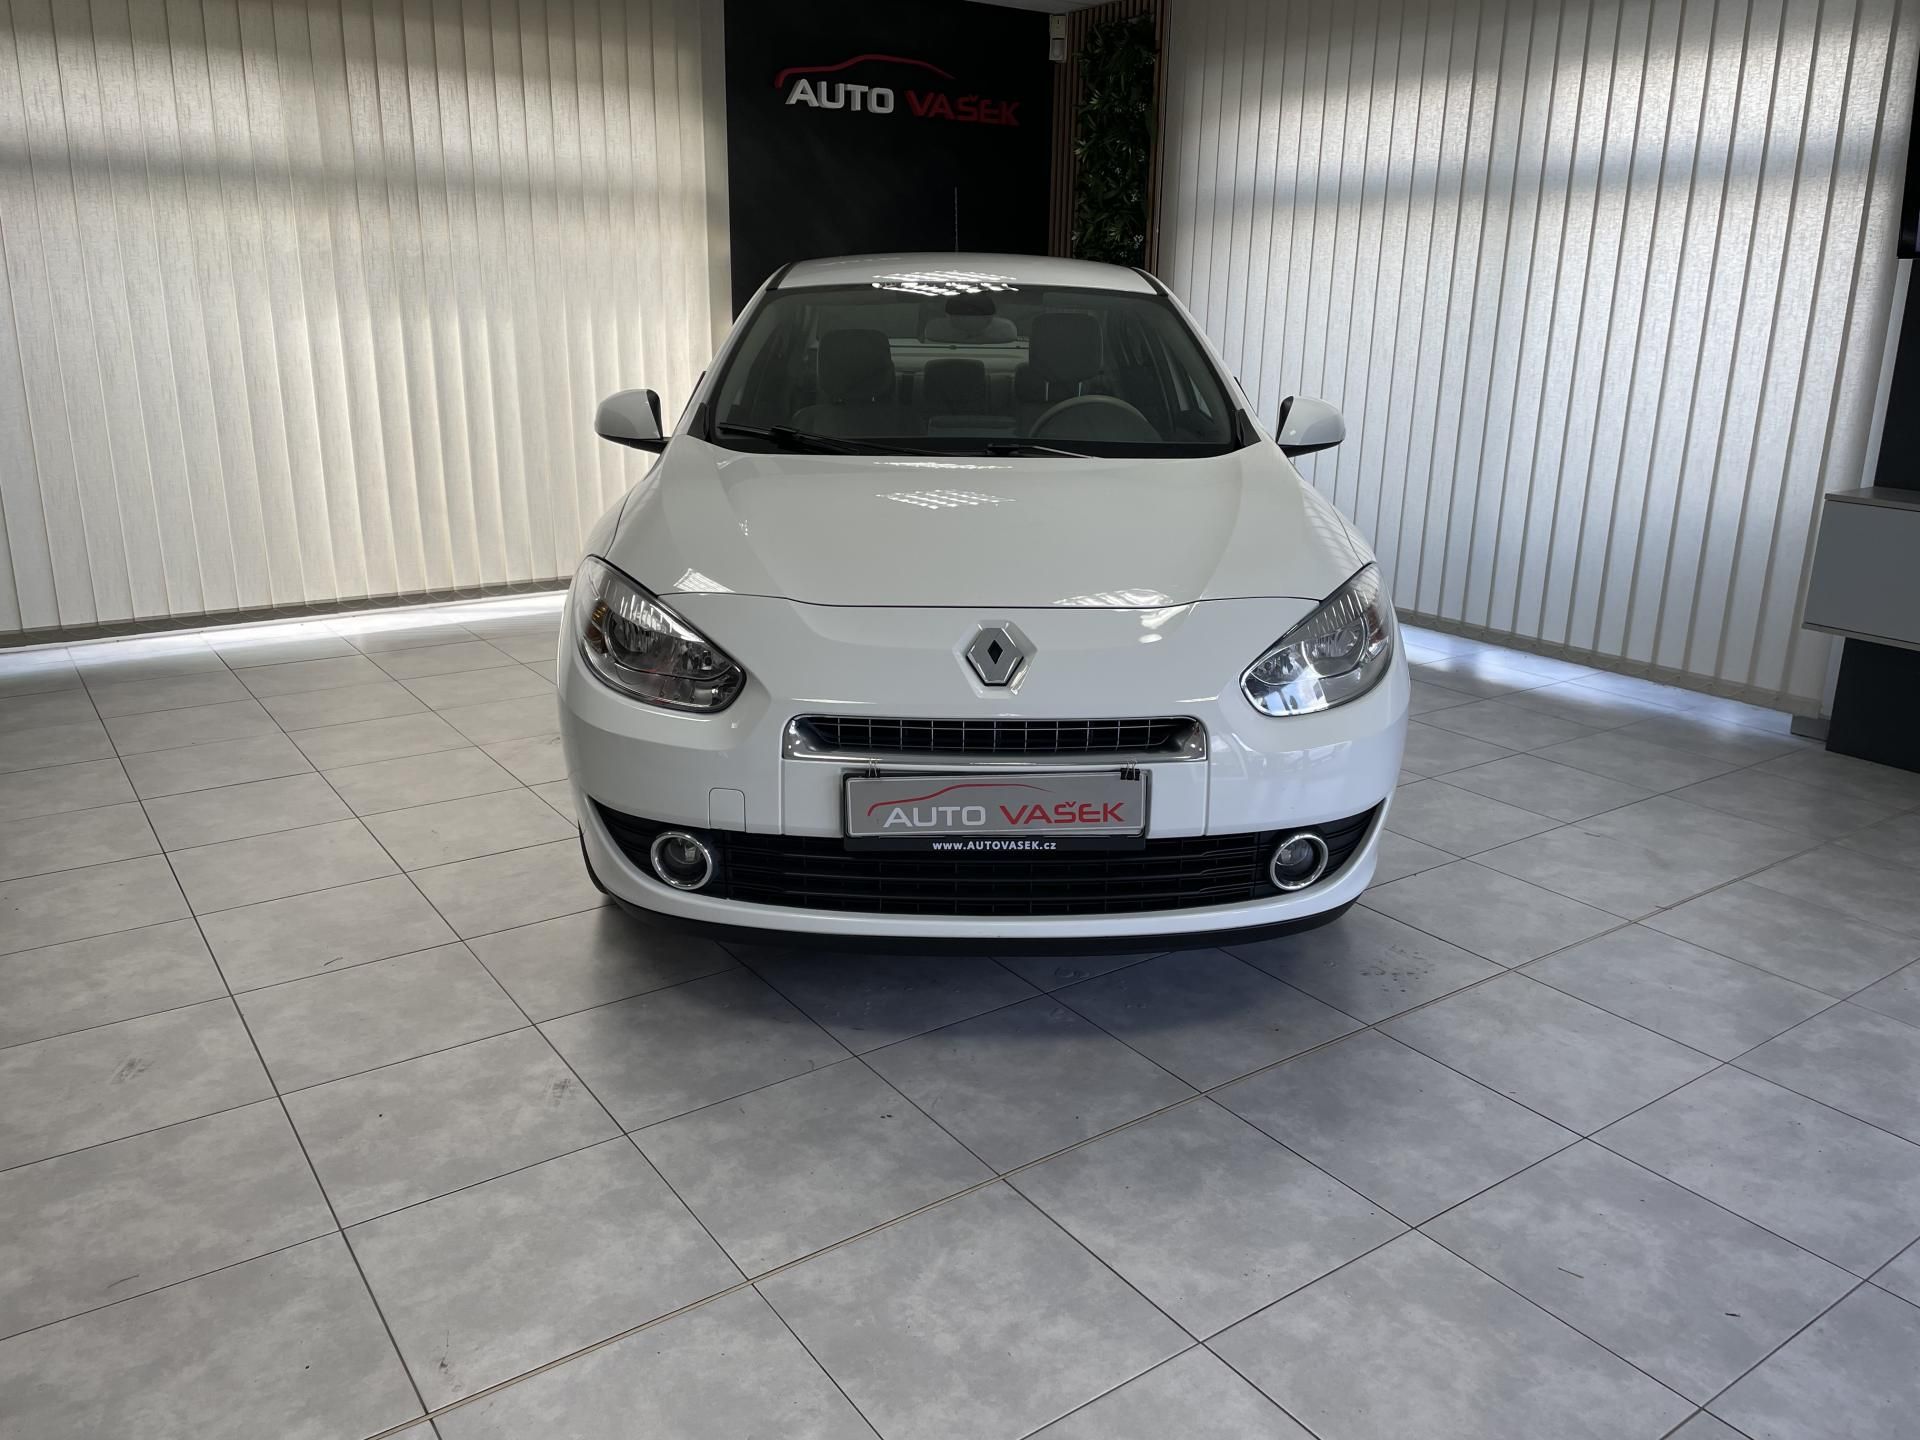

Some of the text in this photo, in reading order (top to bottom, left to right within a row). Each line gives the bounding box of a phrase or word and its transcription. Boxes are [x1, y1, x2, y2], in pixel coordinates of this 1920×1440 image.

[785, 78, 1020, 126] AUTO VAŠEK
[883, 801, 1124, 828] AUTO VAŠEK
[932, 840, 1057, 850] www.AUTOVASEK.cz
